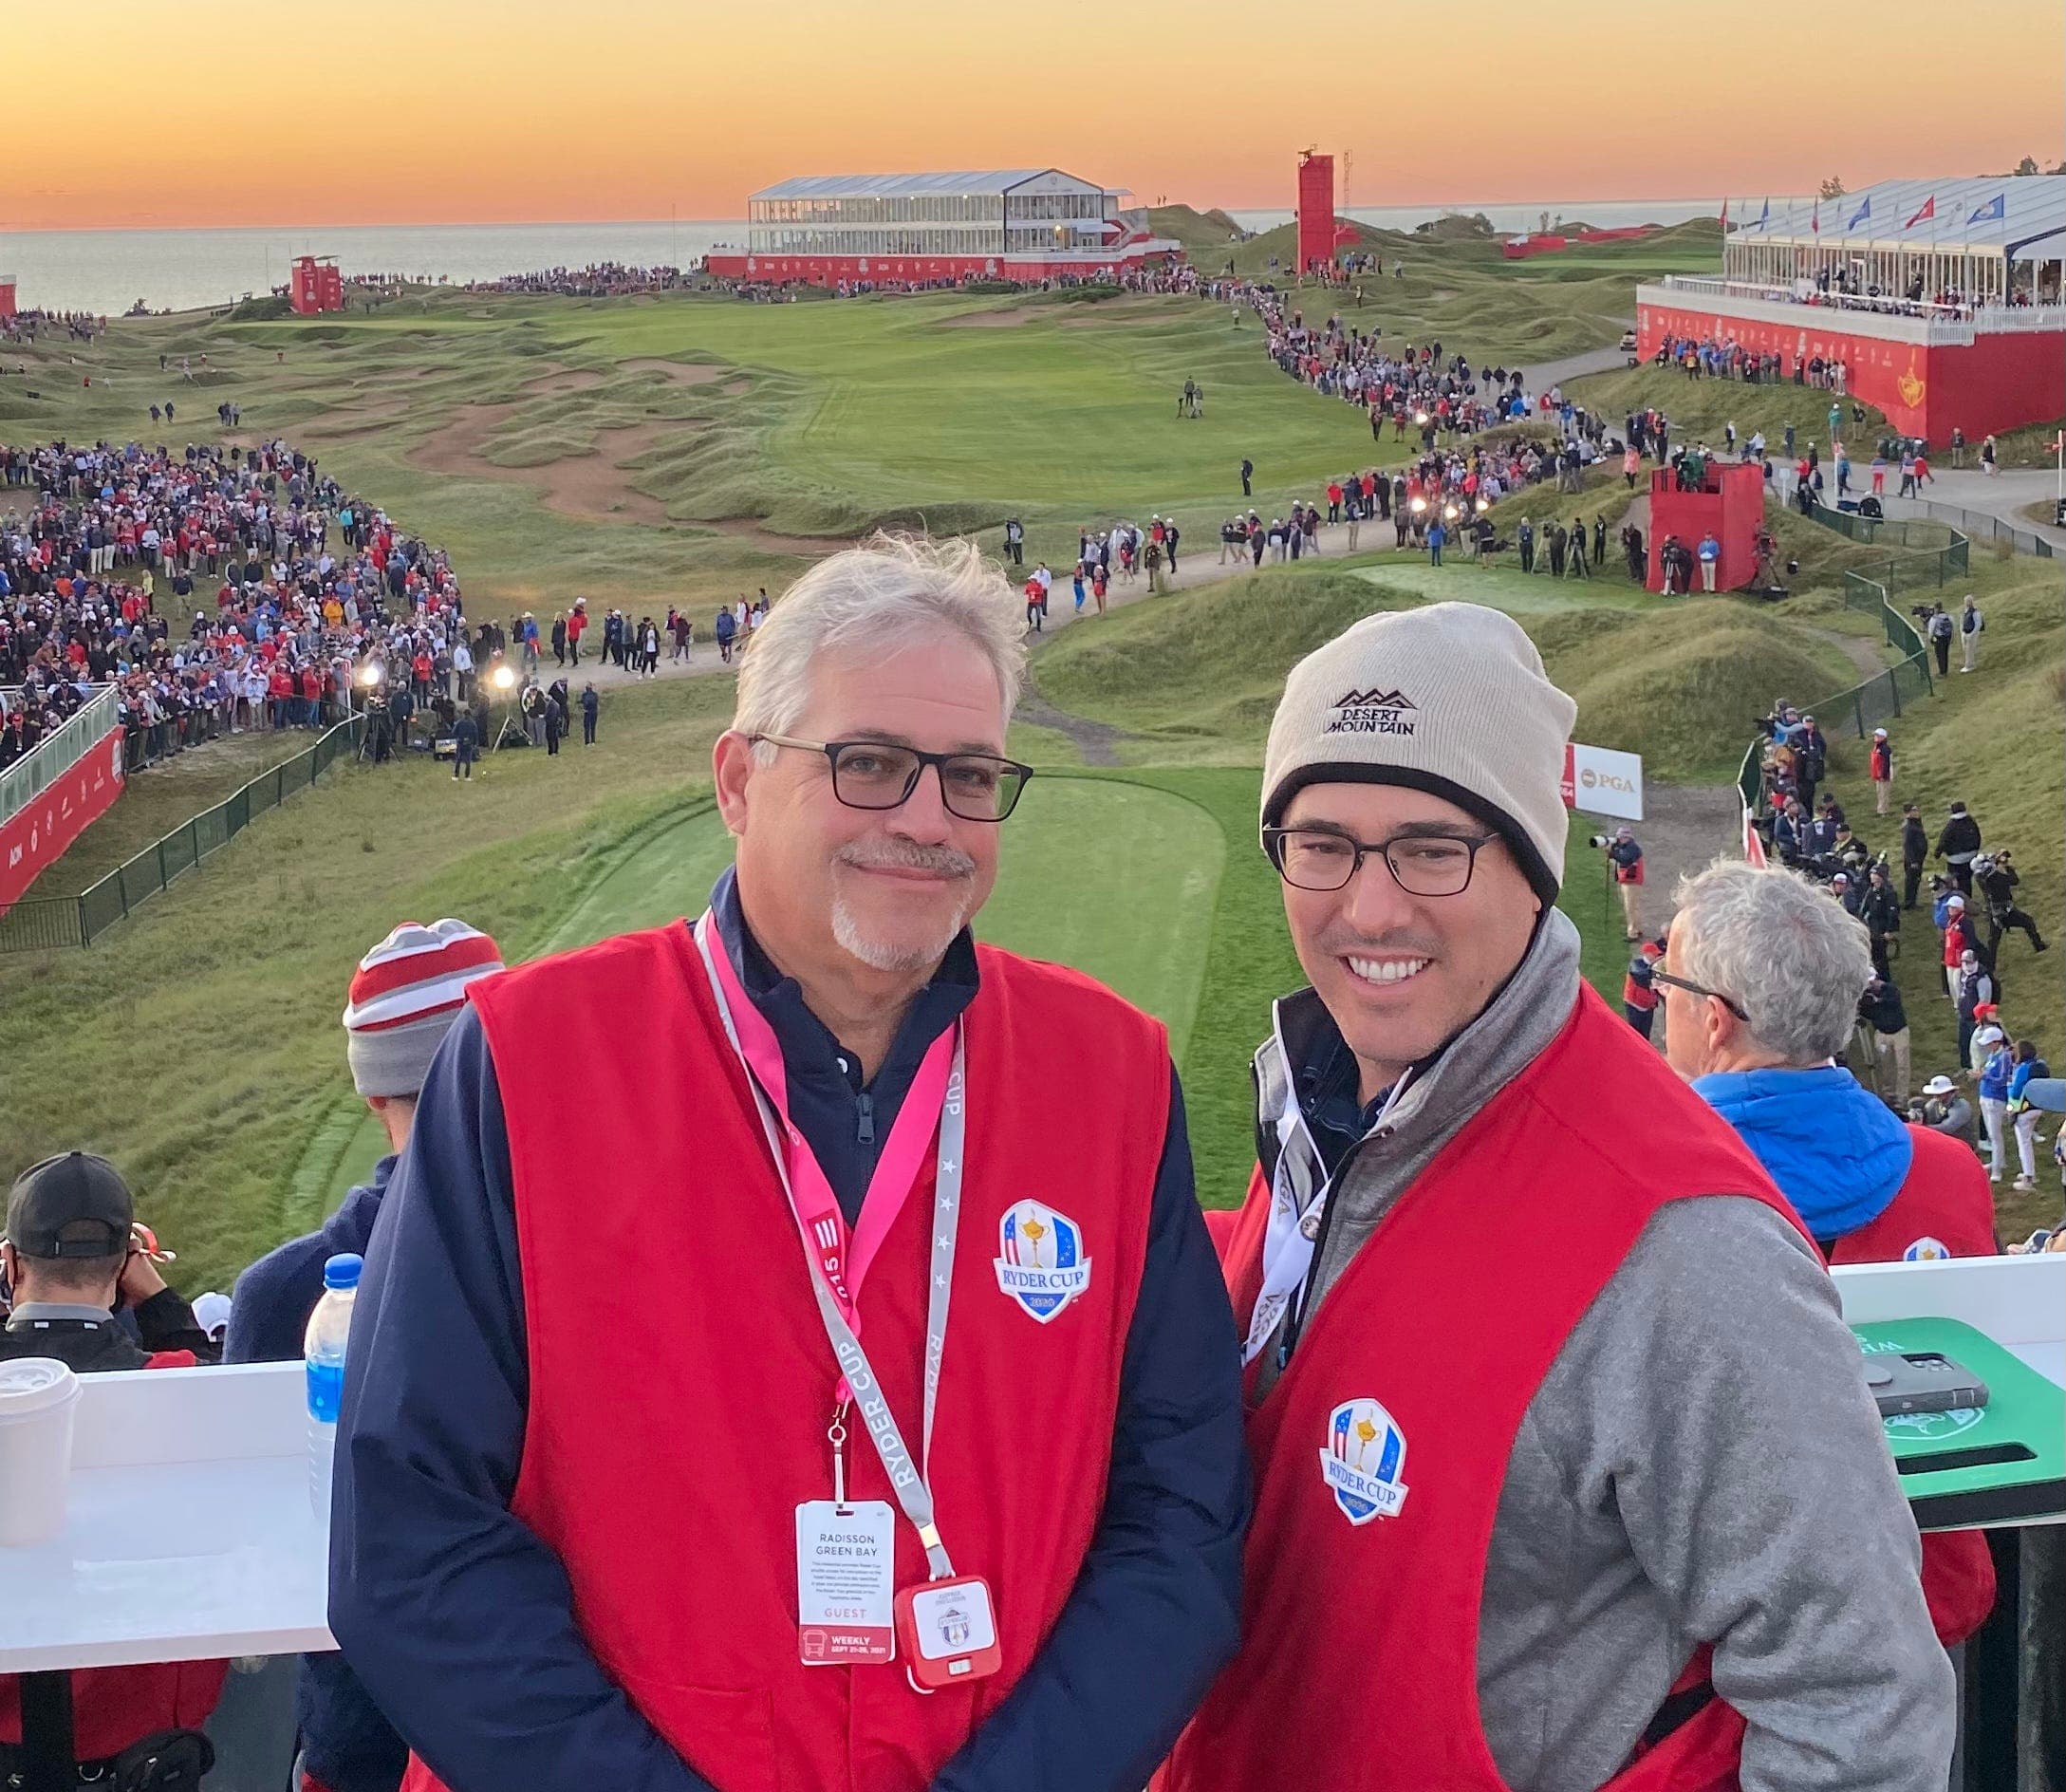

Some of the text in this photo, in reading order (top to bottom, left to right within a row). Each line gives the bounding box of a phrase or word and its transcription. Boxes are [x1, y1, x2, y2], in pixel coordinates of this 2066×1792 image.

[1341, 709, 1403, 721] DESERT
[1324, 720, 1415, 736] MOUNTAIN
[1599, 774, 1636, 793] PGA
[945, 1072, 961, 1115] CUP
[1002, 1269, 1084, 1288] RYDER CUP
[838, 1340, 916, 1489] RYDER CUP
[1329, 1460, 1365, 1493] RYDER
[1367, 1482, 1396, 1505] CUP
[819, 1533, 875, 1544] RADISSON
[815, 1545, 878, 1558] GREEN BAY
[824, 1607, 867, 1618] GUEST
[830, 1635, 871, 1646] WEEKLY
